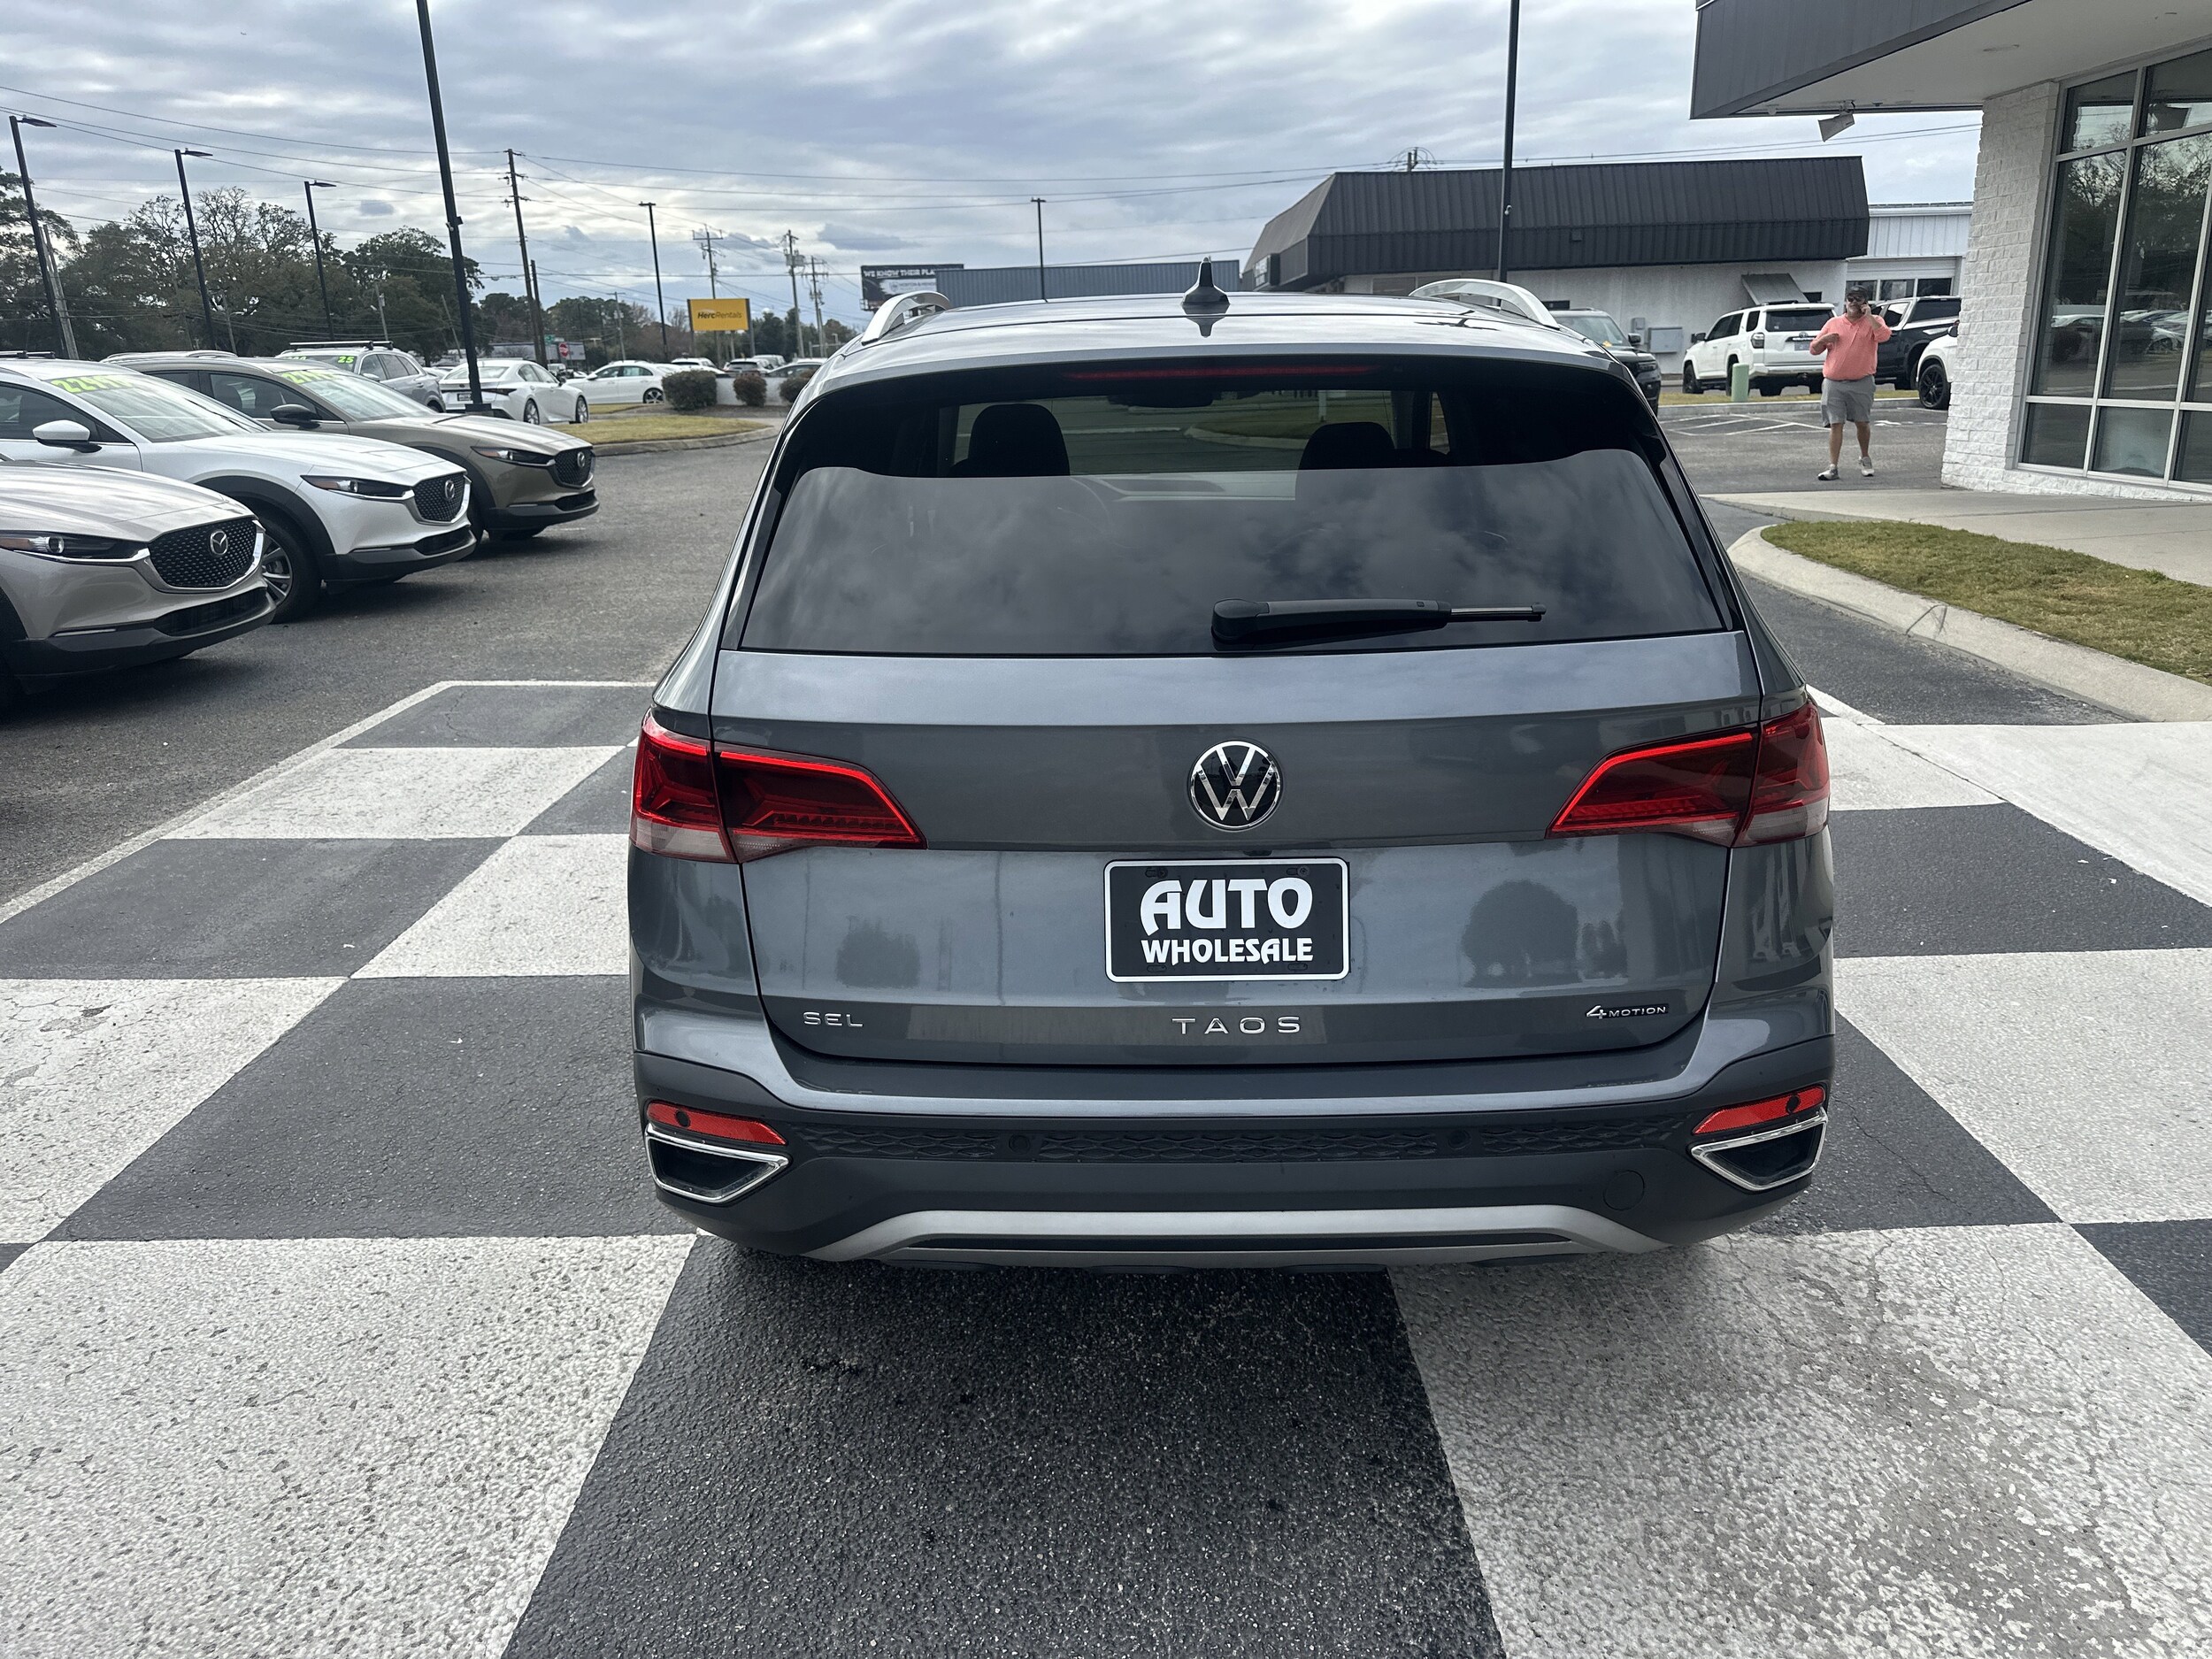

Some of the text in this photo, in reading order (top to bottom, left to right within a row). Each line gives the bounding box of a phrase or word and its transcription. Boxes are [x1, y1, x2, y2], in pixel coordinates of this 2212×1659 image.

[1140, 877, 1313, 936] AUTO
[1141, 938, 1314, 966] WHOLESALE
[803, 1011, 864, 1027] SEL
[1586, 1005, 1666, 1019] 4MOTION
[1171, 1017, 1301, 1035] TAOS
